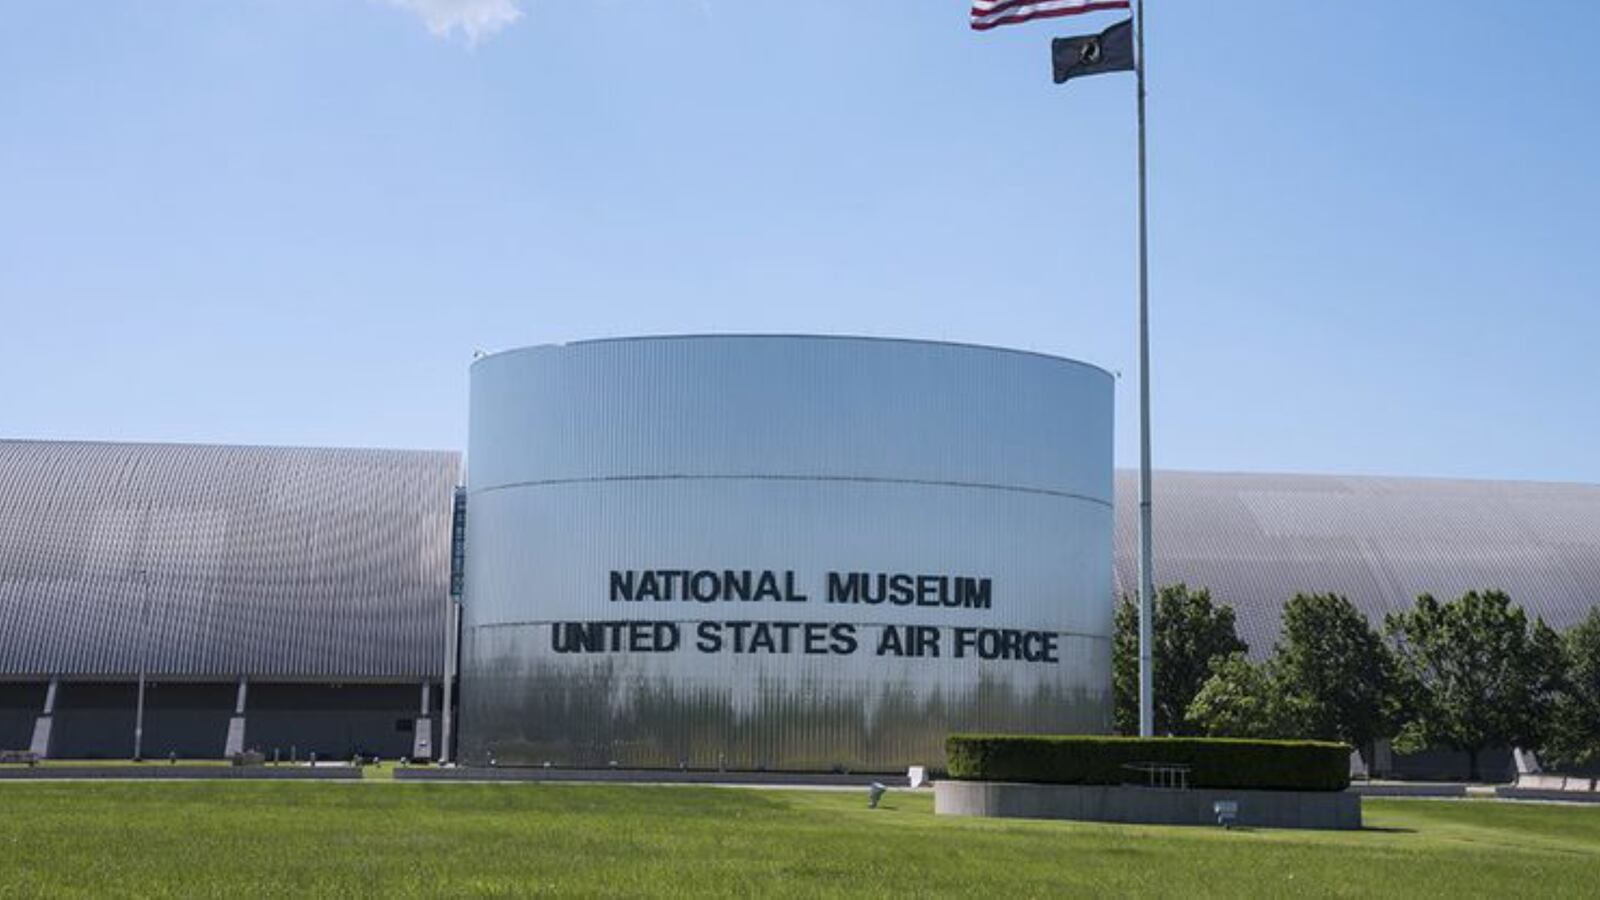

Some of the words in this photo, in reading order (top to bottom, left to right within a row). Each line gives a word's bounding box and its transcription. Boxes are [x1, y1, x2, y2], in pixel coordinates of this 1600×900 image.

[609, 570, 808, 603] NATIONAL
[827, 571, 993, 609] MUSEUM
[551, 622, 680, 653] UNITED
[696, 621, 858, 655] STATES
[876, 625, 941, 658] AIR
[953, 627, 1060, 663] FORCE
